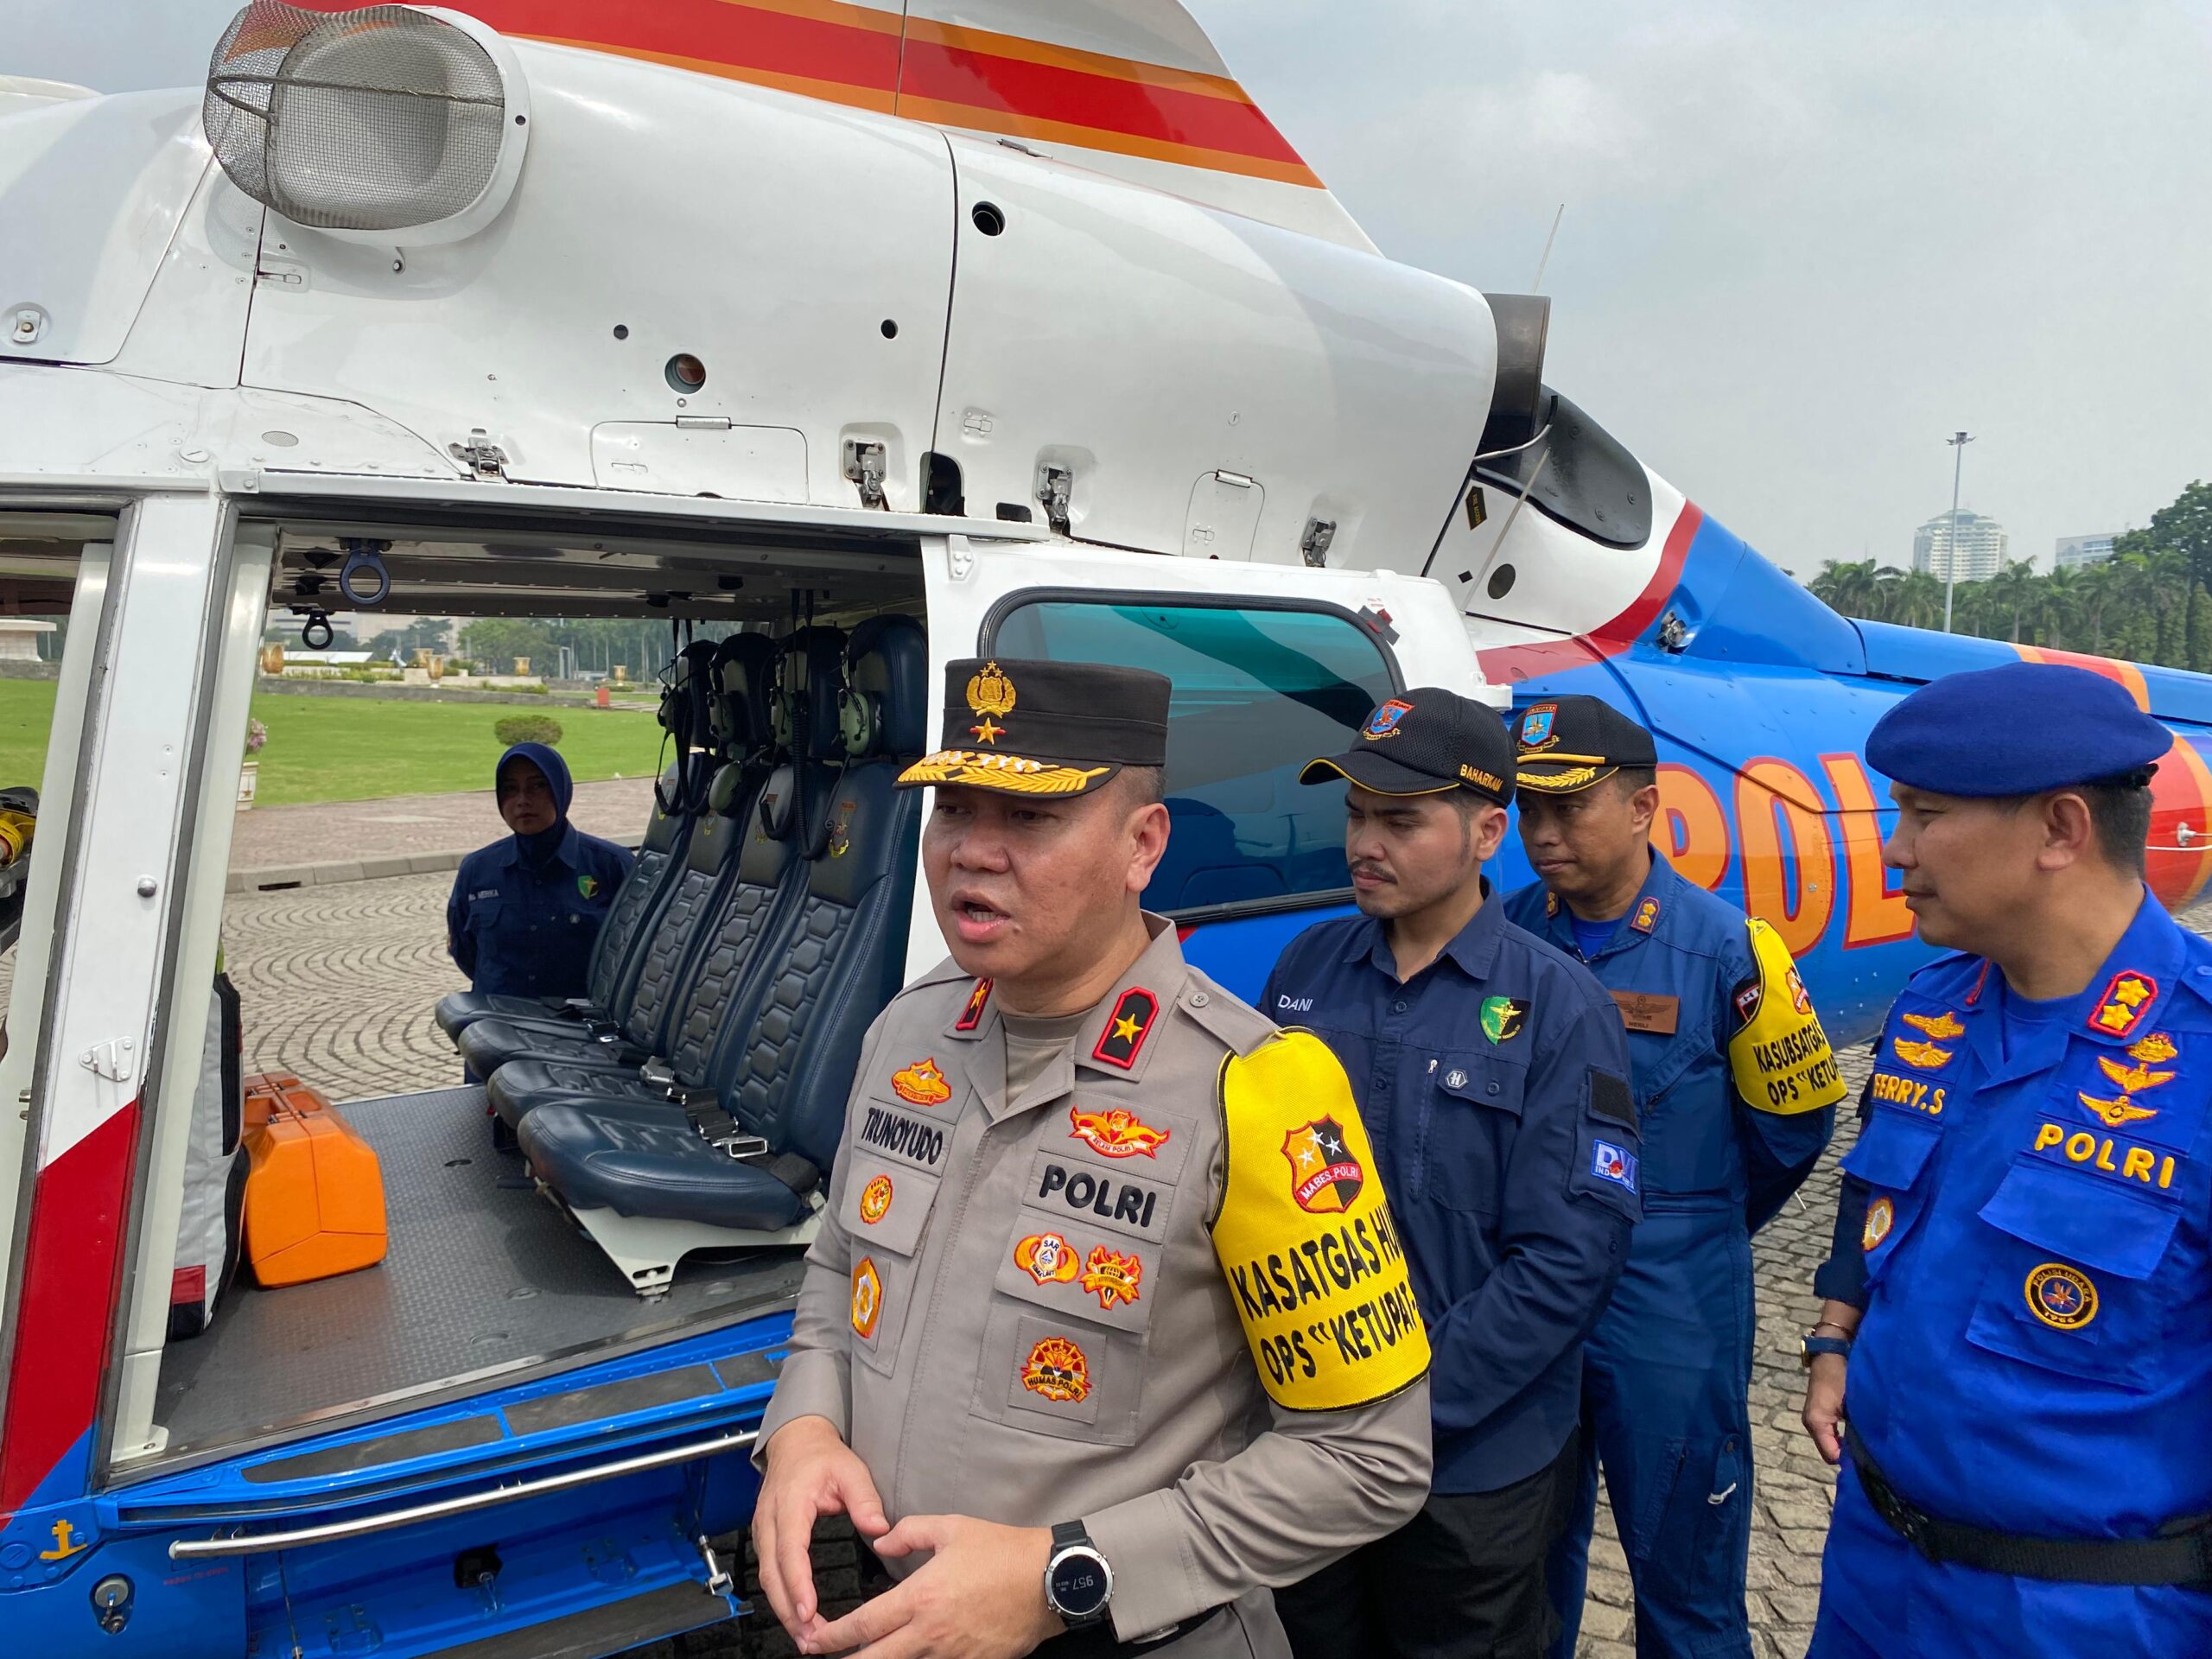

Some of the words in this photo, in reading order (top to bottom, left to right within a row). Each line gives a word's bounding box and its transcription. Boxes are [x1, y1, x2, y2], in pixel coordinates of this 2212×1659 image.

[1460, 764, 1504, 792] BAHARKAM
[1278, 995, 1313, 1011] DANI
[1767, 1075, 1799, 1106] OPS
[861, 1107, 943, 1165] TRUNOYUDO
[2033, 1122, 2177, 1190] POLRI
[1039, 1164, 1156, 1228] POLRI
[1300, 1172, 1331, 1200] MABES
[1333, 1166, 1358, 1181] POLRI
[1044, 1239, 1060, 1251] SAR
[1230, 1218, 1381, 1321] KASATGAS
[2033, 1269, 2062, 1287] POLISI
[2064, 1272, 2093, 1302] UDARA
[1261, 1333, 1317, 1385] OPS
[1027, 1377, 1056, 1386] HUMAS
[1058, 1380, 1082, 1398] POLRI
